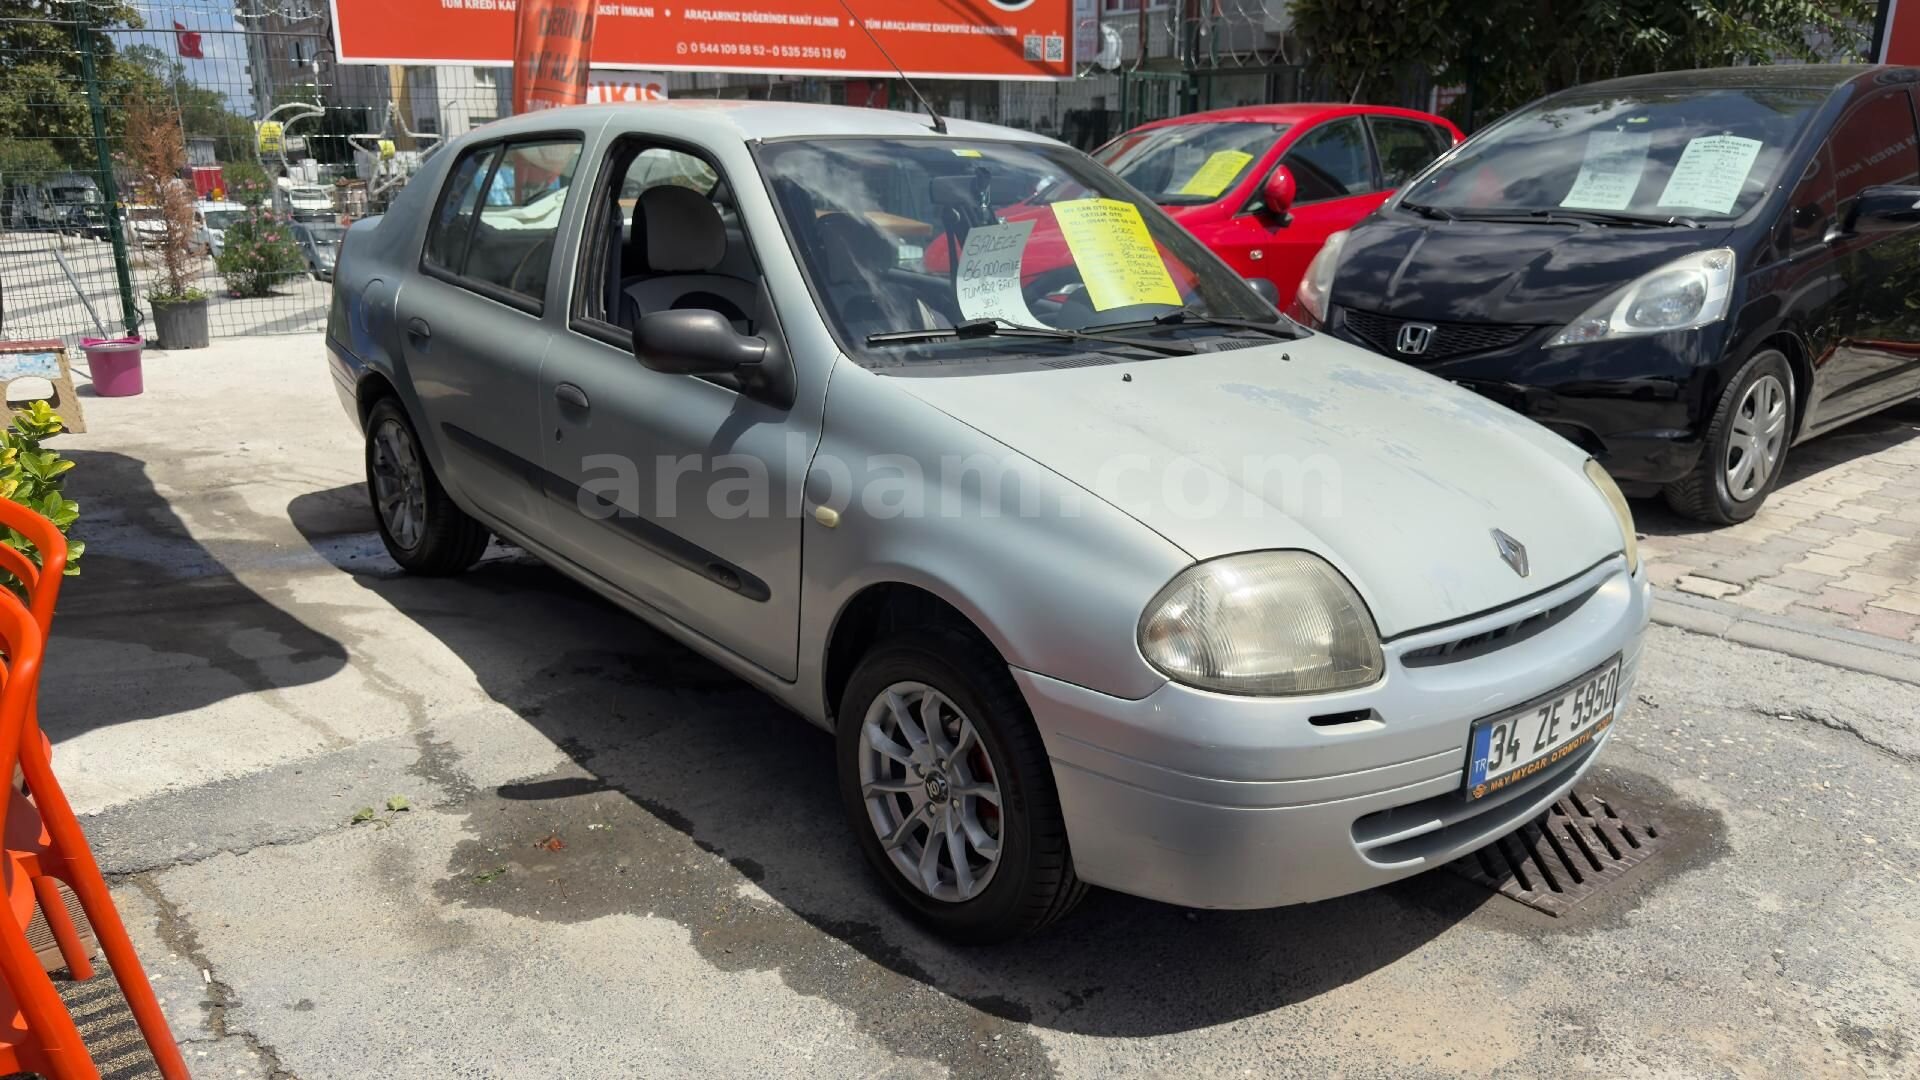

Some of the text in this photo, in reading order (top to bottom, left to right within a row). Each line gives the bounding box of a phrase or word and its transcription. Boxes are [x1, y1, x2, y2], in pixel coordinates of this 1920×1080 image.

[690, 42, 698, 54] 0
[699, 42, 719, 55] 544
[720, 44, 737, 55] 109
[1474, 667, 1617, 773] TR 34 ZE 5950
